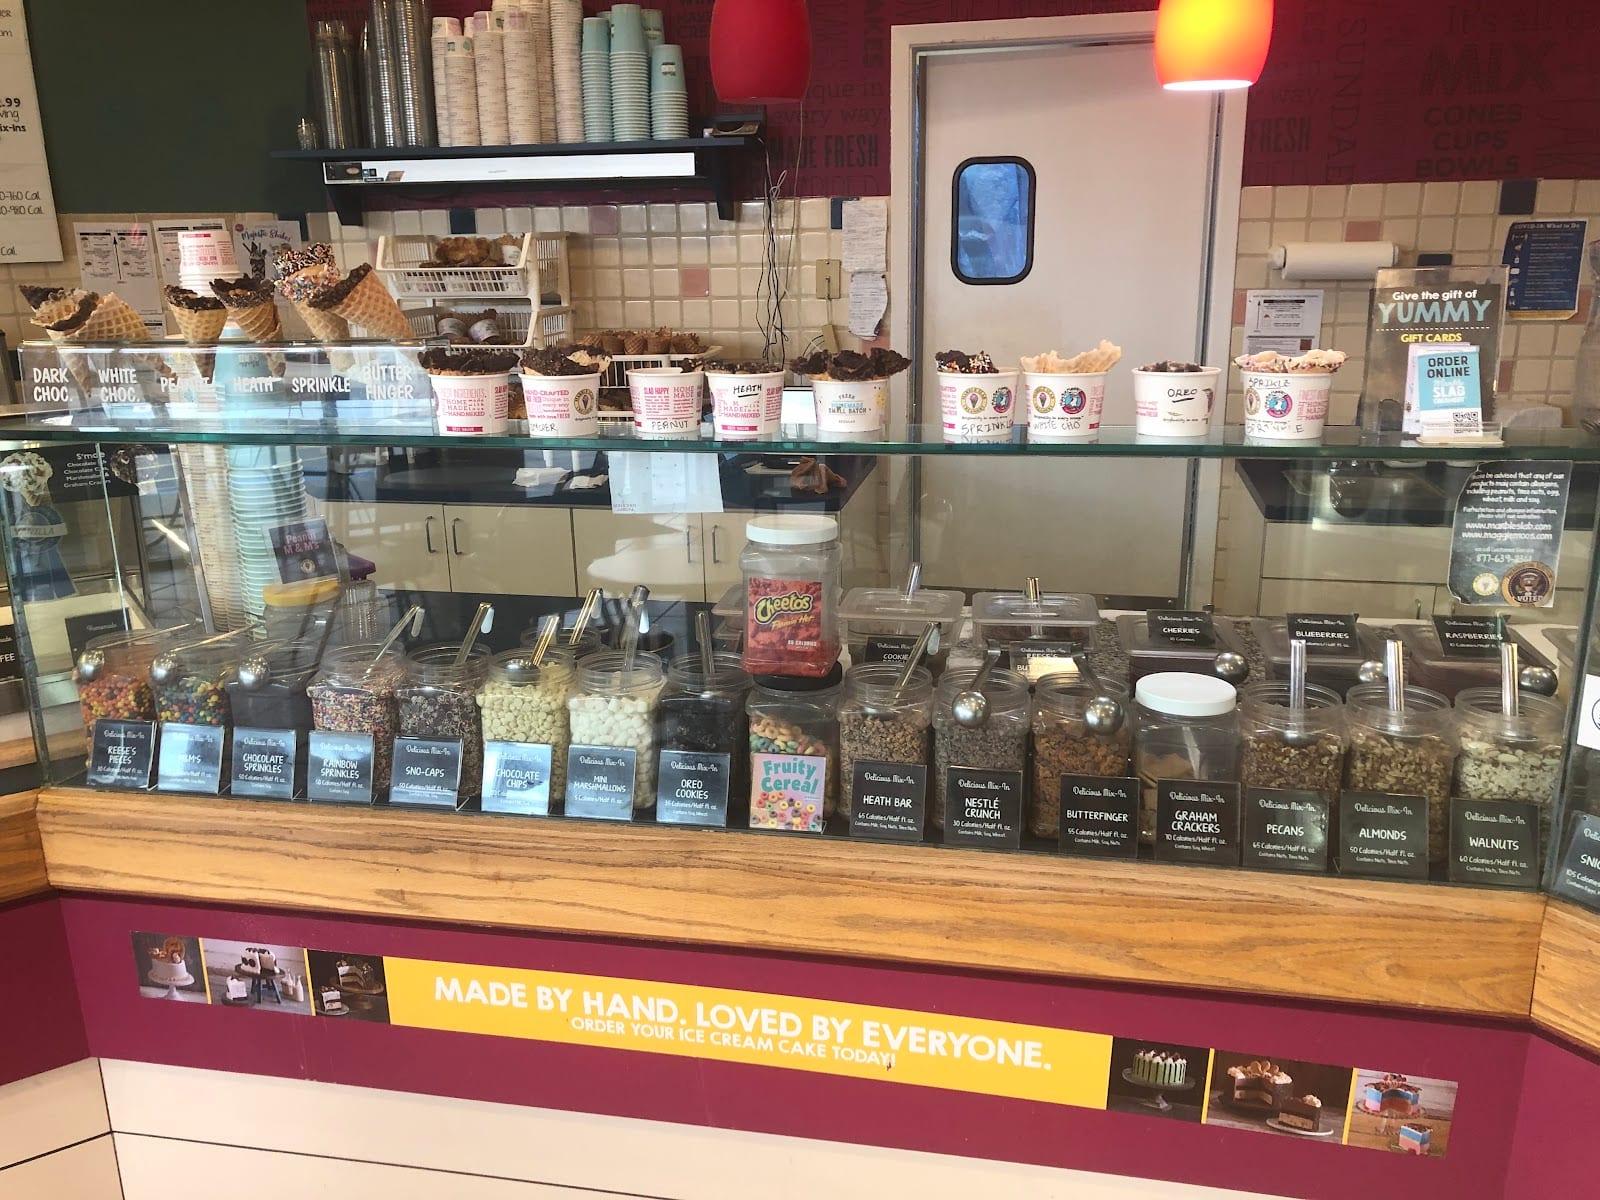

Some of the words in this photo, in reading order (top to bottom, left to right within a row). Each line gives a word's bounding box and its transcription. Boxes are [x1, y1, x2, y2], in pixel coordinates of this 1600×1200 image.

[1423, 103, 1523, 127] CONES
[1432, 131, 1510, 150] CUPS
[824, 134, 879, 168] FRESH
[1415, 155, 1520, 179] BOWLS
[241, 230, 268, 240] Majestic
[1392, 292, 1418, 300] Give
[1421, 291, 1439, 300] the
[1442, 290, 1462, 301] gift
[1465, 290, 1478, 299] of
[1378, 300, 1492, 324] YUMMY
[1400, 334, 1423, 342] GIFT
[1425, 333, 1462, 342] CARDS
[1428, 356, 1468, 367] ORDER
[33, 368, 69, 383] DARK
[98, 368, 137, 384] WHITE
[363, 365, 412, 381] BUTTER
[1427, 367, 1470, 378] ONLINE
[232, 377, 274, 392] HEATH
[292, 377, 351, 393] SPRINKLE
[733, 384, 762, 394] HEATH
[33, 387, 73, 402] CHOC.
[101, 387, 140, 402] CHOC.
[366, 386, 414, 399] FINGER
[1167, 388, 1198, 397] OREO
[1433, 386, 1465, 398] SLAB
[652, 421, 688, 430] PEANUT
[1061, 421, 1080, 430] CHO
[76, 452, 105, 460] S'moe
[1466, 522, 1552, 530] www.marbleslab.com
[286, 532, 317, 544] Peanut
[1462, 531, 1553, 540] www.maggiemoos.com
[756, 593, 810, 622] Cheetos
[1295, 630, 1350, 639] BLUEBERRIES
[0, 653, 15, 661] FEE
[244, 737, 265, 746] Delicious
[108, 746, 136, 755] REESE'S
[406, 745, 430, 754] Delicious
[109, 755, 132, 764] PIECES
[243, 753, 283, 764] CHOCOLATE
[323, 759, 357, 769] RAINBOW
[580, 756, 604, 765] Delicious
[605, 758, 625, 767] Mix-In
[244, 763, 282, 773] SPRINKLES
[406, 766, 445, 777] SNO-CAPS
[671, 760, 696, 770] Delicious
[697, 763, 718, 772] Mix-In
[763, 757, 817, 780] Fruity
[321, 768, 359, 779] SPRINKLES
[496, 769, 540, 780] CHOCOLATE
[864, 772, 891, 783] Delicious
[893, 775, 915, 785] Mix-In
[506, 779, 528, 788] CHIPS
[574, 781, 626, 792] MARSHMALLOWS
[681, 779, 703, 789] OREO
[761, 777, 818, 794] Cereal
[958, 779, 986, 789] Delicious
[987, 780, 1010, 791] Mix-In
[676, 789, 709, 799] COOKIES
[1073, 786, 1102, 796] Delicious
[1103, 788, 1127, 798] Mix-In
[1169, 792, 1200, 802] Delicious
[1201, 793, 1225, 803] Mix-In
[863, 795, 892, 807] HEATH
[894, 797, 912, 808] BAR
[965, 797, 999, 809] NESTLÉ
[1259, 799, 1289, 810] Delicious
[1290, 801, 1316, 812] Mix-In
[965, 808, 1000, 819] CRUNCH
[1354, 803, 1386, 814] Delicious
[1387, 805, 1413, 816] Mix-In
[858, 812, 865, 820] 65
[866, 813, 900, 822] Calories/Half
[1066, 810, 1129, 822] BUTTERFINGER
[1175, 810, 1218, 822] GRAHAM
[1465, 811, 1498, 823] Delicious
[1499, 814, 1526, 825] Mix-In
[961, 821, 997, 830] Calories/Half
[1171, 821, 1221, 834] CRACKERS
[1266, 824, 1304, 836] PECANS
[1076, 828, 1113, 838] Calories/Half
[1359, 828, 1407, 841] ALMONDS
[1584, 828, 1600, 842] Delic
[1173, 835, 1210, 844] Calories/Half
[1469, 836, 1519, 851] WALNUTS
[1261, 842, 1299, 852] Calories/Half
[1350, 846, 1358, 854] 50
[1358, 847, 1399, 857] Calories/Half
[1469, 856, 1510, 867] Calories/Half
[1580, 854, 1600, 871] SNIC
[435, 976, 528, 1008] MADE
[536, 986, 573, 1013] BY
[583, 991, 687, 1025] HAND.
[696, 1001, 802, 1037] LOVED
[812, 1015, 851, 1043] BY
[862, 1020, 1052, 1071] EVERYONE.
[571, 1016, 626, 1036] ORDER
[630, 1022, 675, 1041] YOUR
[679, 1028, 705, 1044] ICE
[710, 1031, 774, 1052] CREAM
[778, 1038, 827, 1058] CAKE
